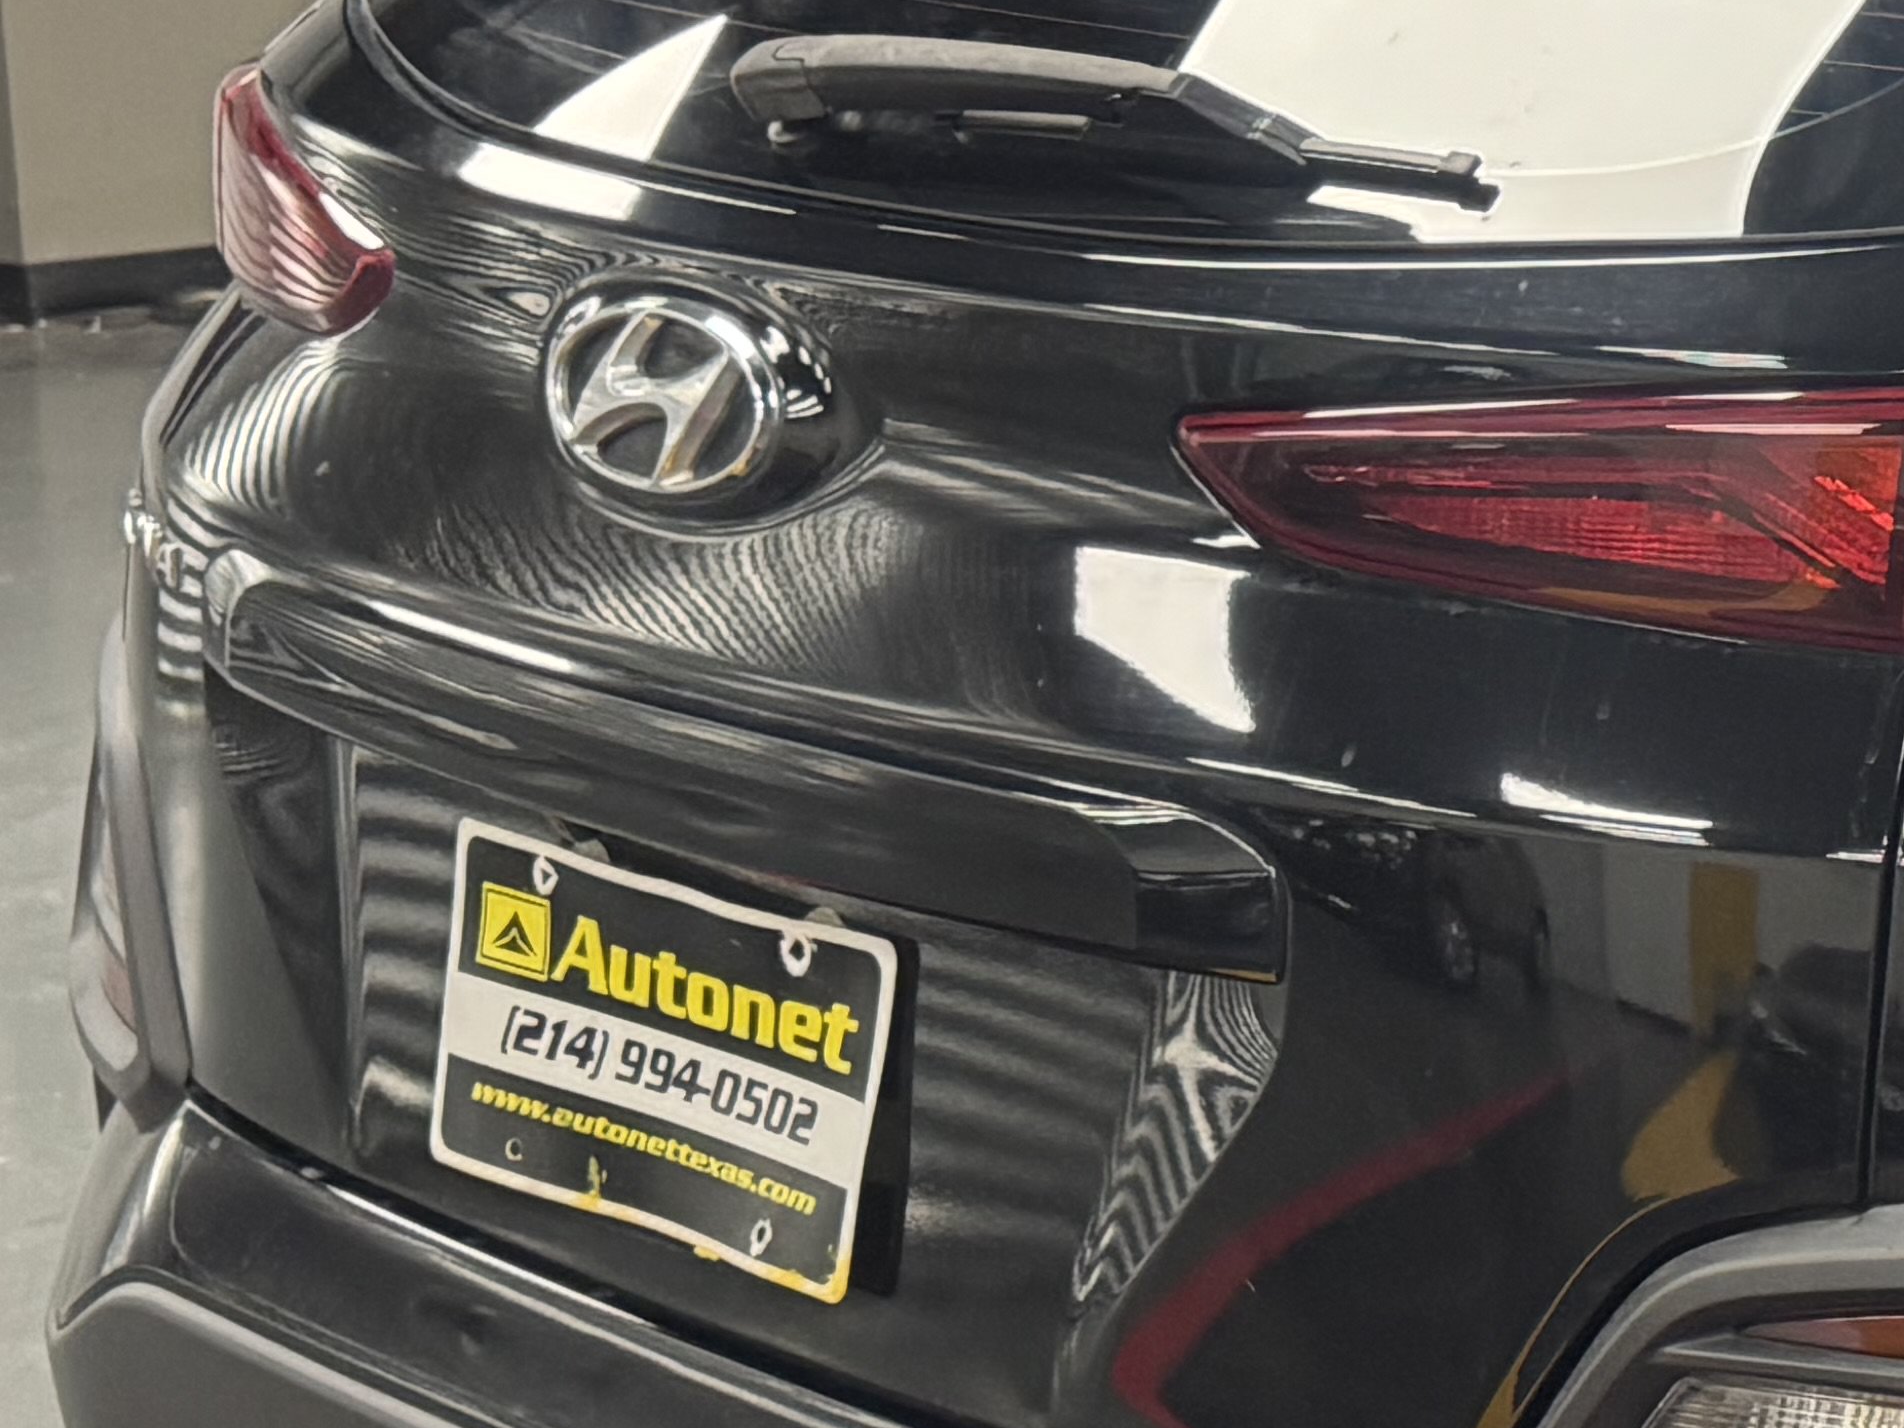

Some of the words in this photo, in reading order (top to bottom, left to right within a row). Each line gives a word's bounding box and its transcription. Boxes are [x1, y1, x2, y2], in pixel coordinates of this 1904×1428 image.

[551, 914, 859, 1075] Autonet
[500, 1005, 610, 1080] (214)
[614, 1039, 819, 1146] 994-0502
[471, 1081, 816, 1215] www.autonettexas.com
